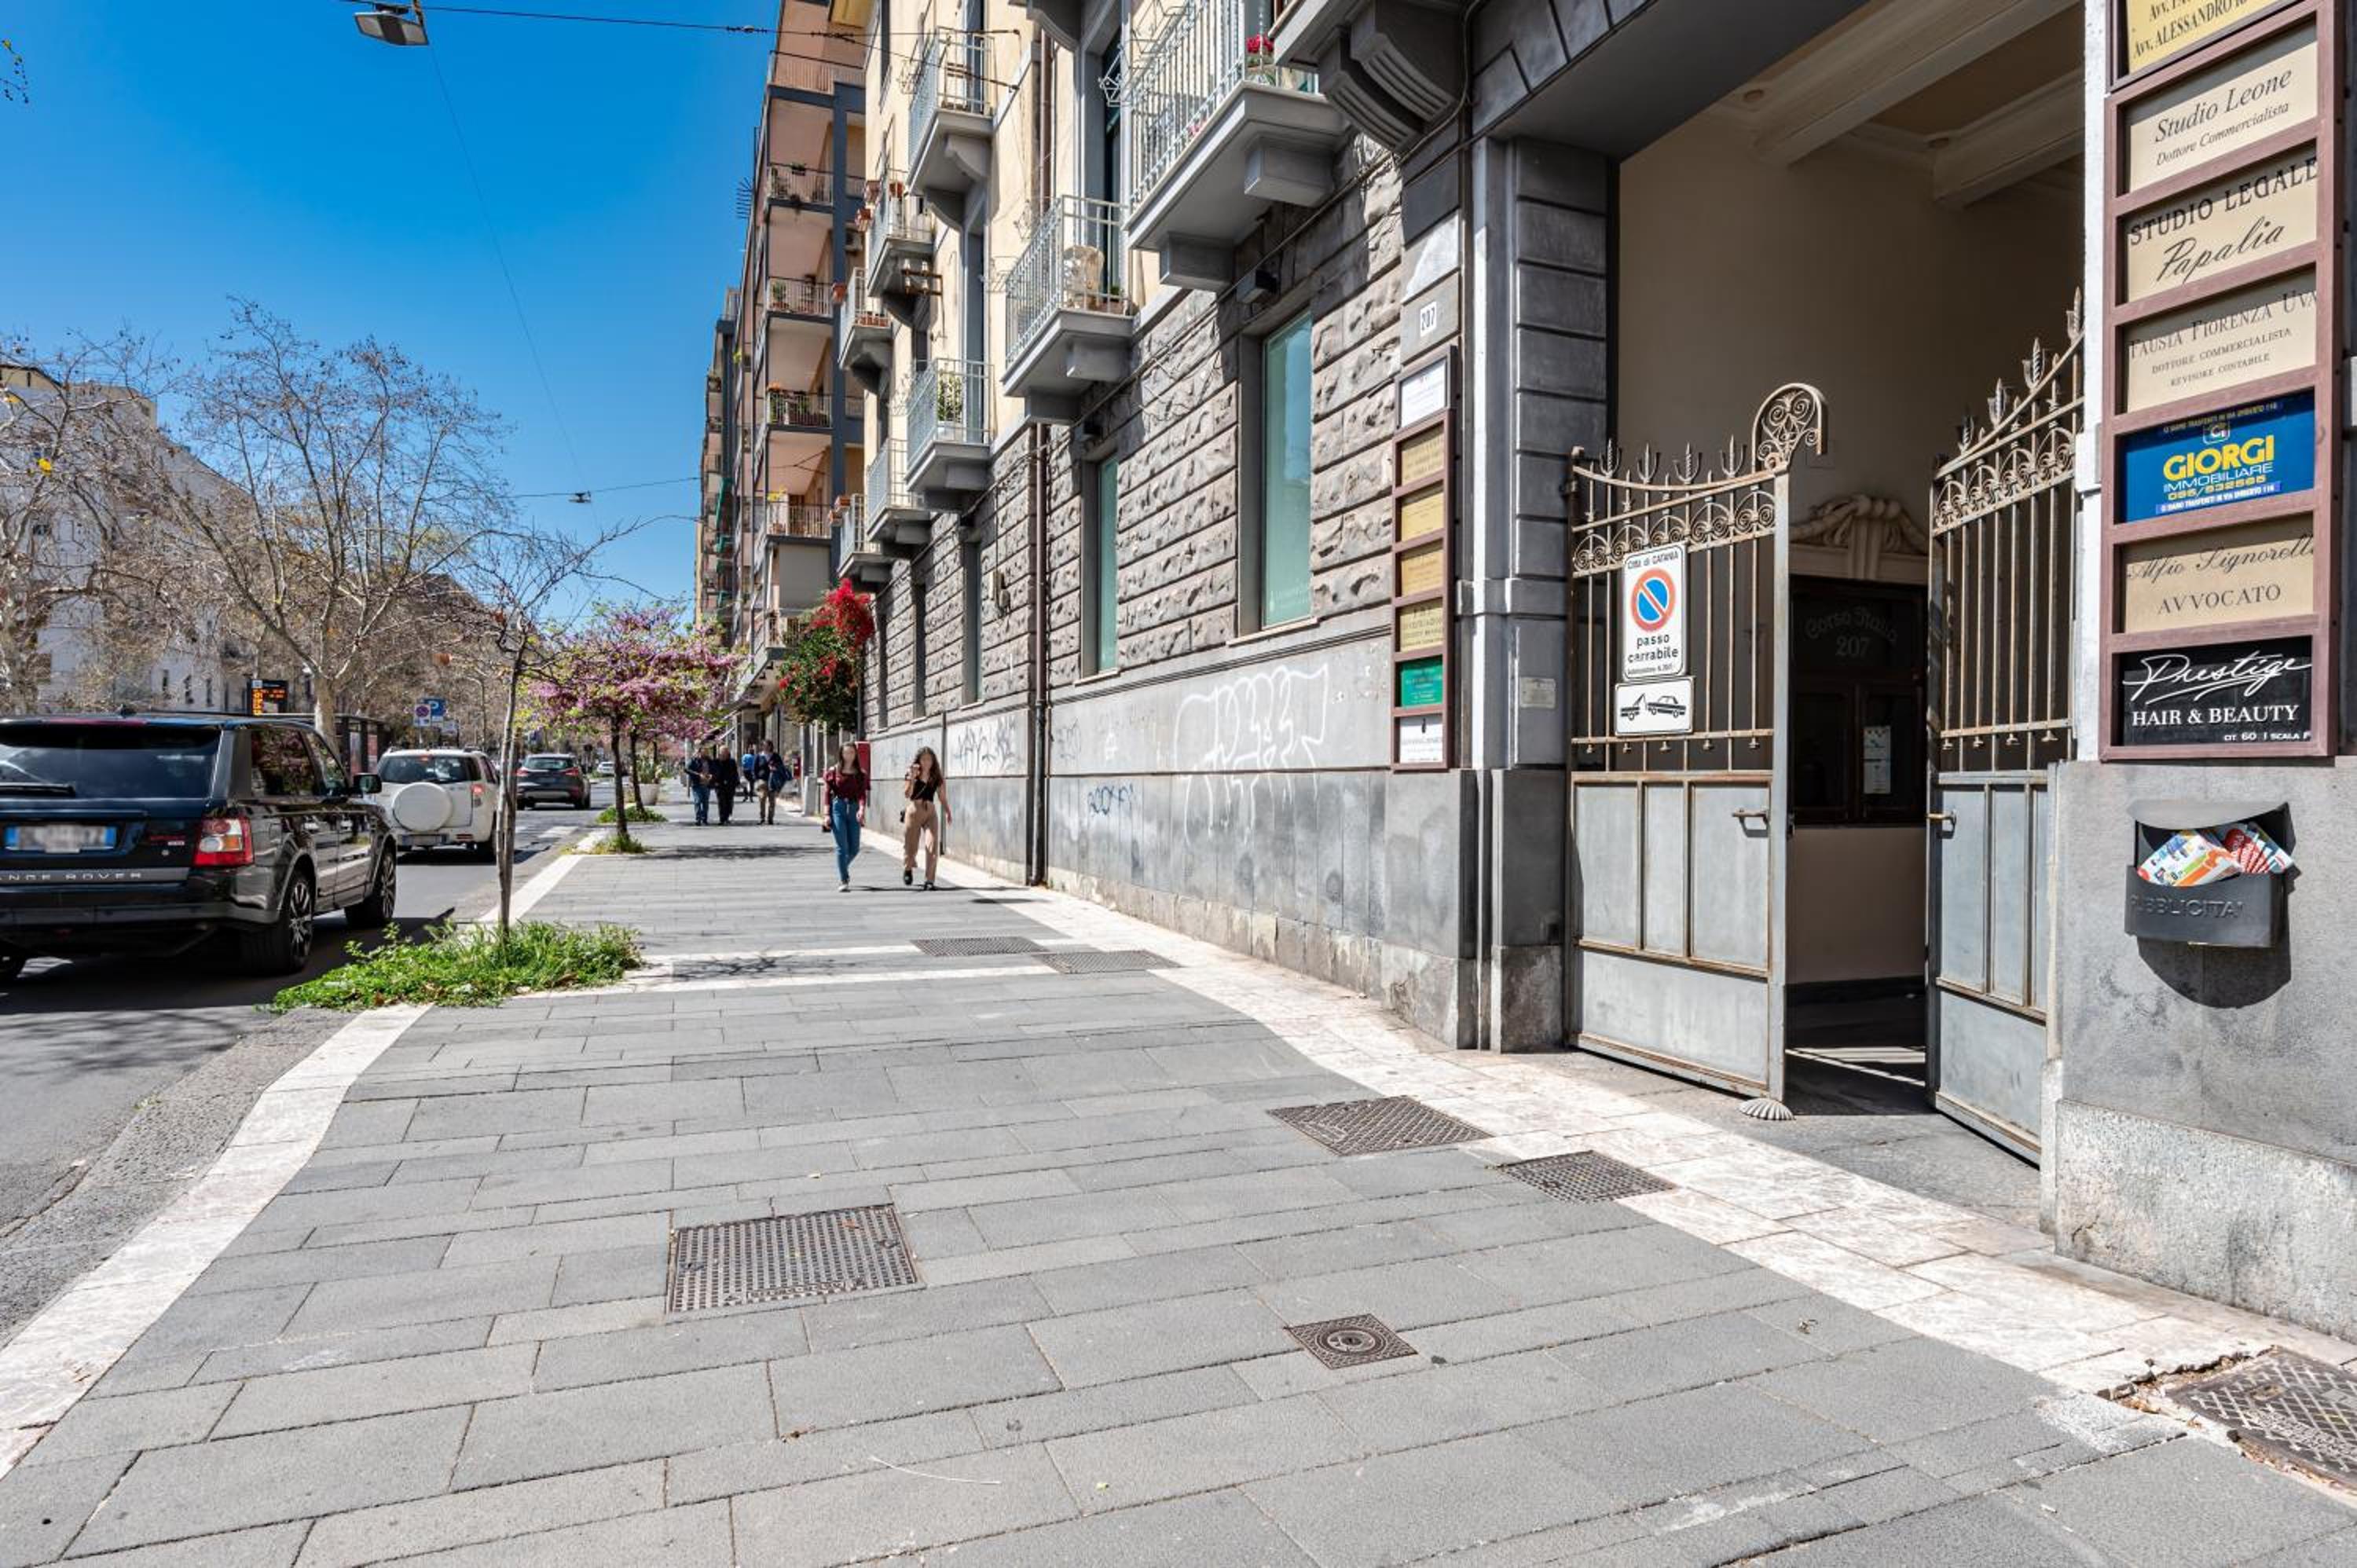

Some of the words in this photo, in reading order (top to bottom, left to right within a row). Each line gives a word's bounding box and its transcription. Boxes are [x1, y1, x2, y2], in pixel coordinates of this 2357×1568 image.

[2155, 102, 2218, 142] Studio
[2223, 70, 2292, 113] Leone
[2157, 142, 2197, 165] Dottore
[2199, 103, 2289, 146] Commercialista
[2130, 199, 2212, 245] STUDIO
[2224, 158, 2317, 211] LEGALE
[2156, 216, 2284, 285] Papalia
[1421, 307, 1435, 331] 207
[2152, 355, 2194, 375] DOTTORE
[2199, 328, 2292, 359] COMMERCIALISTA
[2163, 434, 2275, 482] GIORGI
[2163, 462, 2273, 493] IMMOBILIARE
[2127, 554, 2185, 583] Alfio
[2158, 584, 2282, 614] AVVOCATO
[1627, 647, 1678, 663] carrabile
[1637, 634, 1670, 649] passo
[1835, 636, 1871, 658] 207
[2122, 650, 2312, 702] Prestige
[2132, 709, 2182, 726] HAIR
[2188, 709, 2203, 724] &
[2209, 705, 2299, 724] BEAUTY
[2242, 731, 2257, 741] 60
